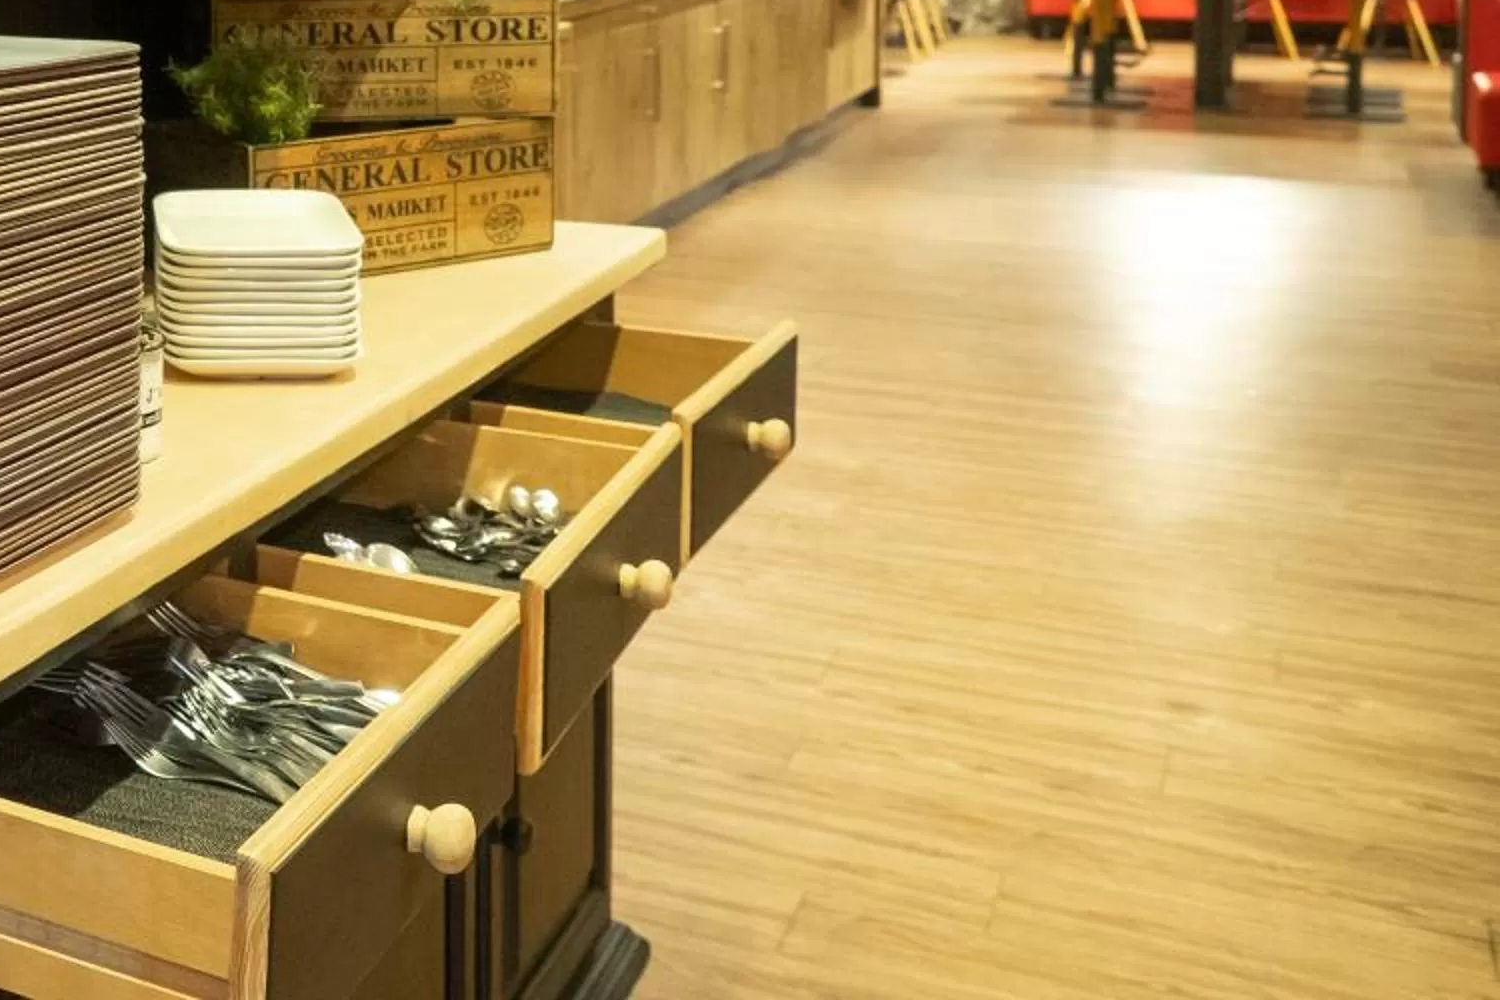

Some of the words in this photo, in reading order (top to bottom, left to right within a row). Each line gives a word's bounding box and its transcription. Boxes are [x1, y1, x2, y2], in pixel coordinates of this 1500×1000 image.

[425, 15, 549, 43] STORE
[265, 156, 431, 194] GENERAL
[446, 142, 549, 180] STORE
[364, 227, 447, 249] SELECTED
